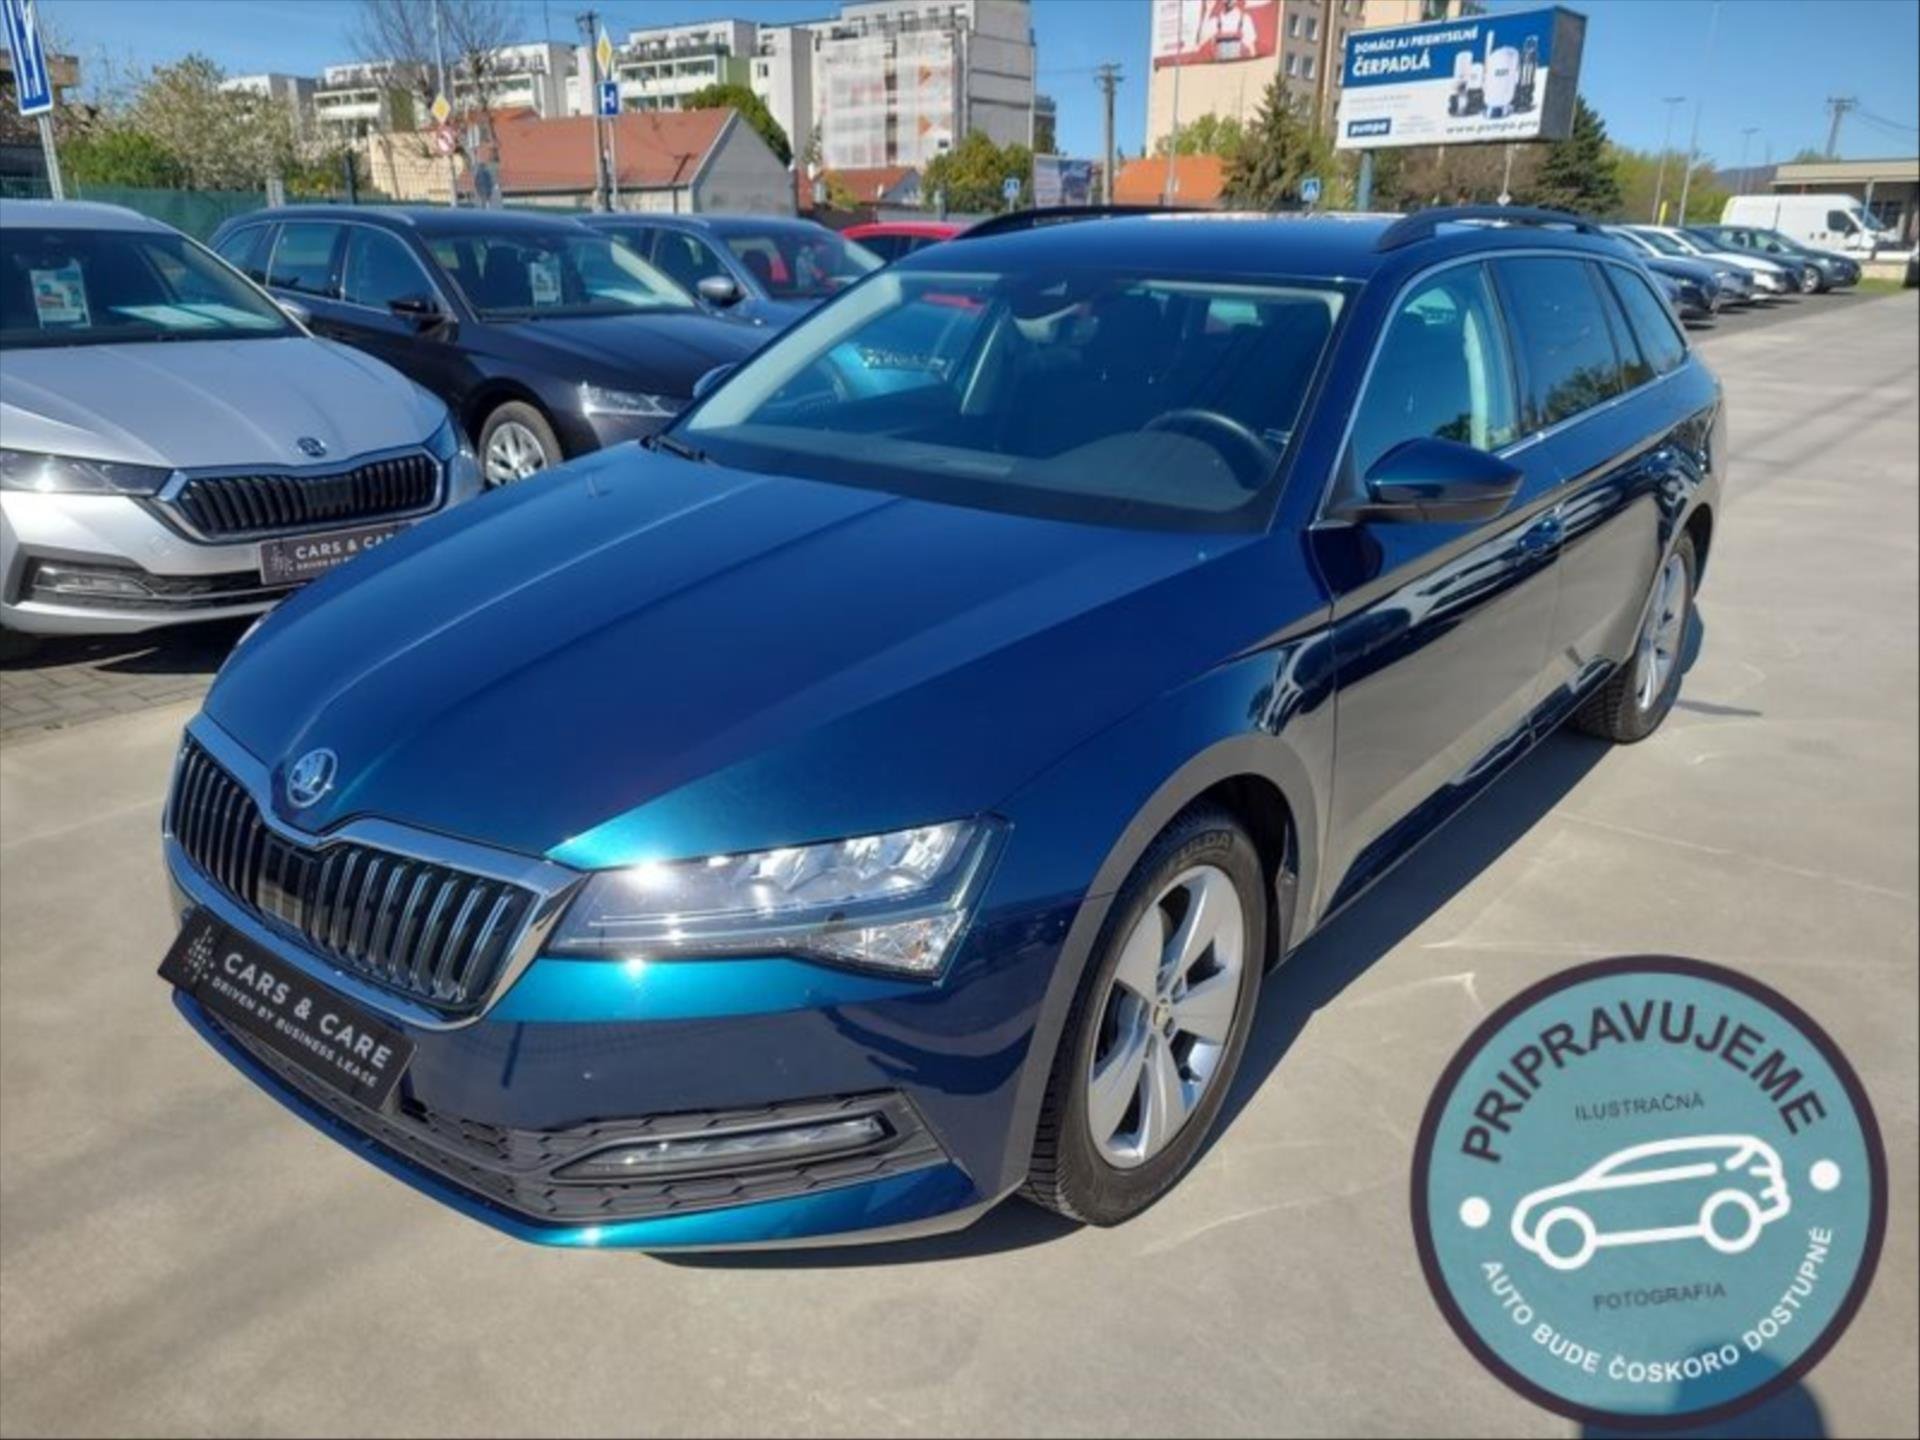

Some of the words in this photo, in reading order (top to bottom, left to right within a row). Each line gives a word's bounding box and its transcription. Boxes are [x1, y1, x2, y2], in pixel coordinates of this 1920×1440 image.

[1352, 47, 1430, 77] ČERPADLÁ
[296, 541, 341, 560] CARS
[211, 977, 255, 1011] DRIVEN
[257, 1007, 275, 1021] BY
[275, 1018, 335, 1060] BUSINESS
[336, 1055, 378, 1089] LEASE
[224, 953, 291, 1004] CARS
[294, 997, 312, 1021] &
[319, 1013, 392, 1070] CARE
